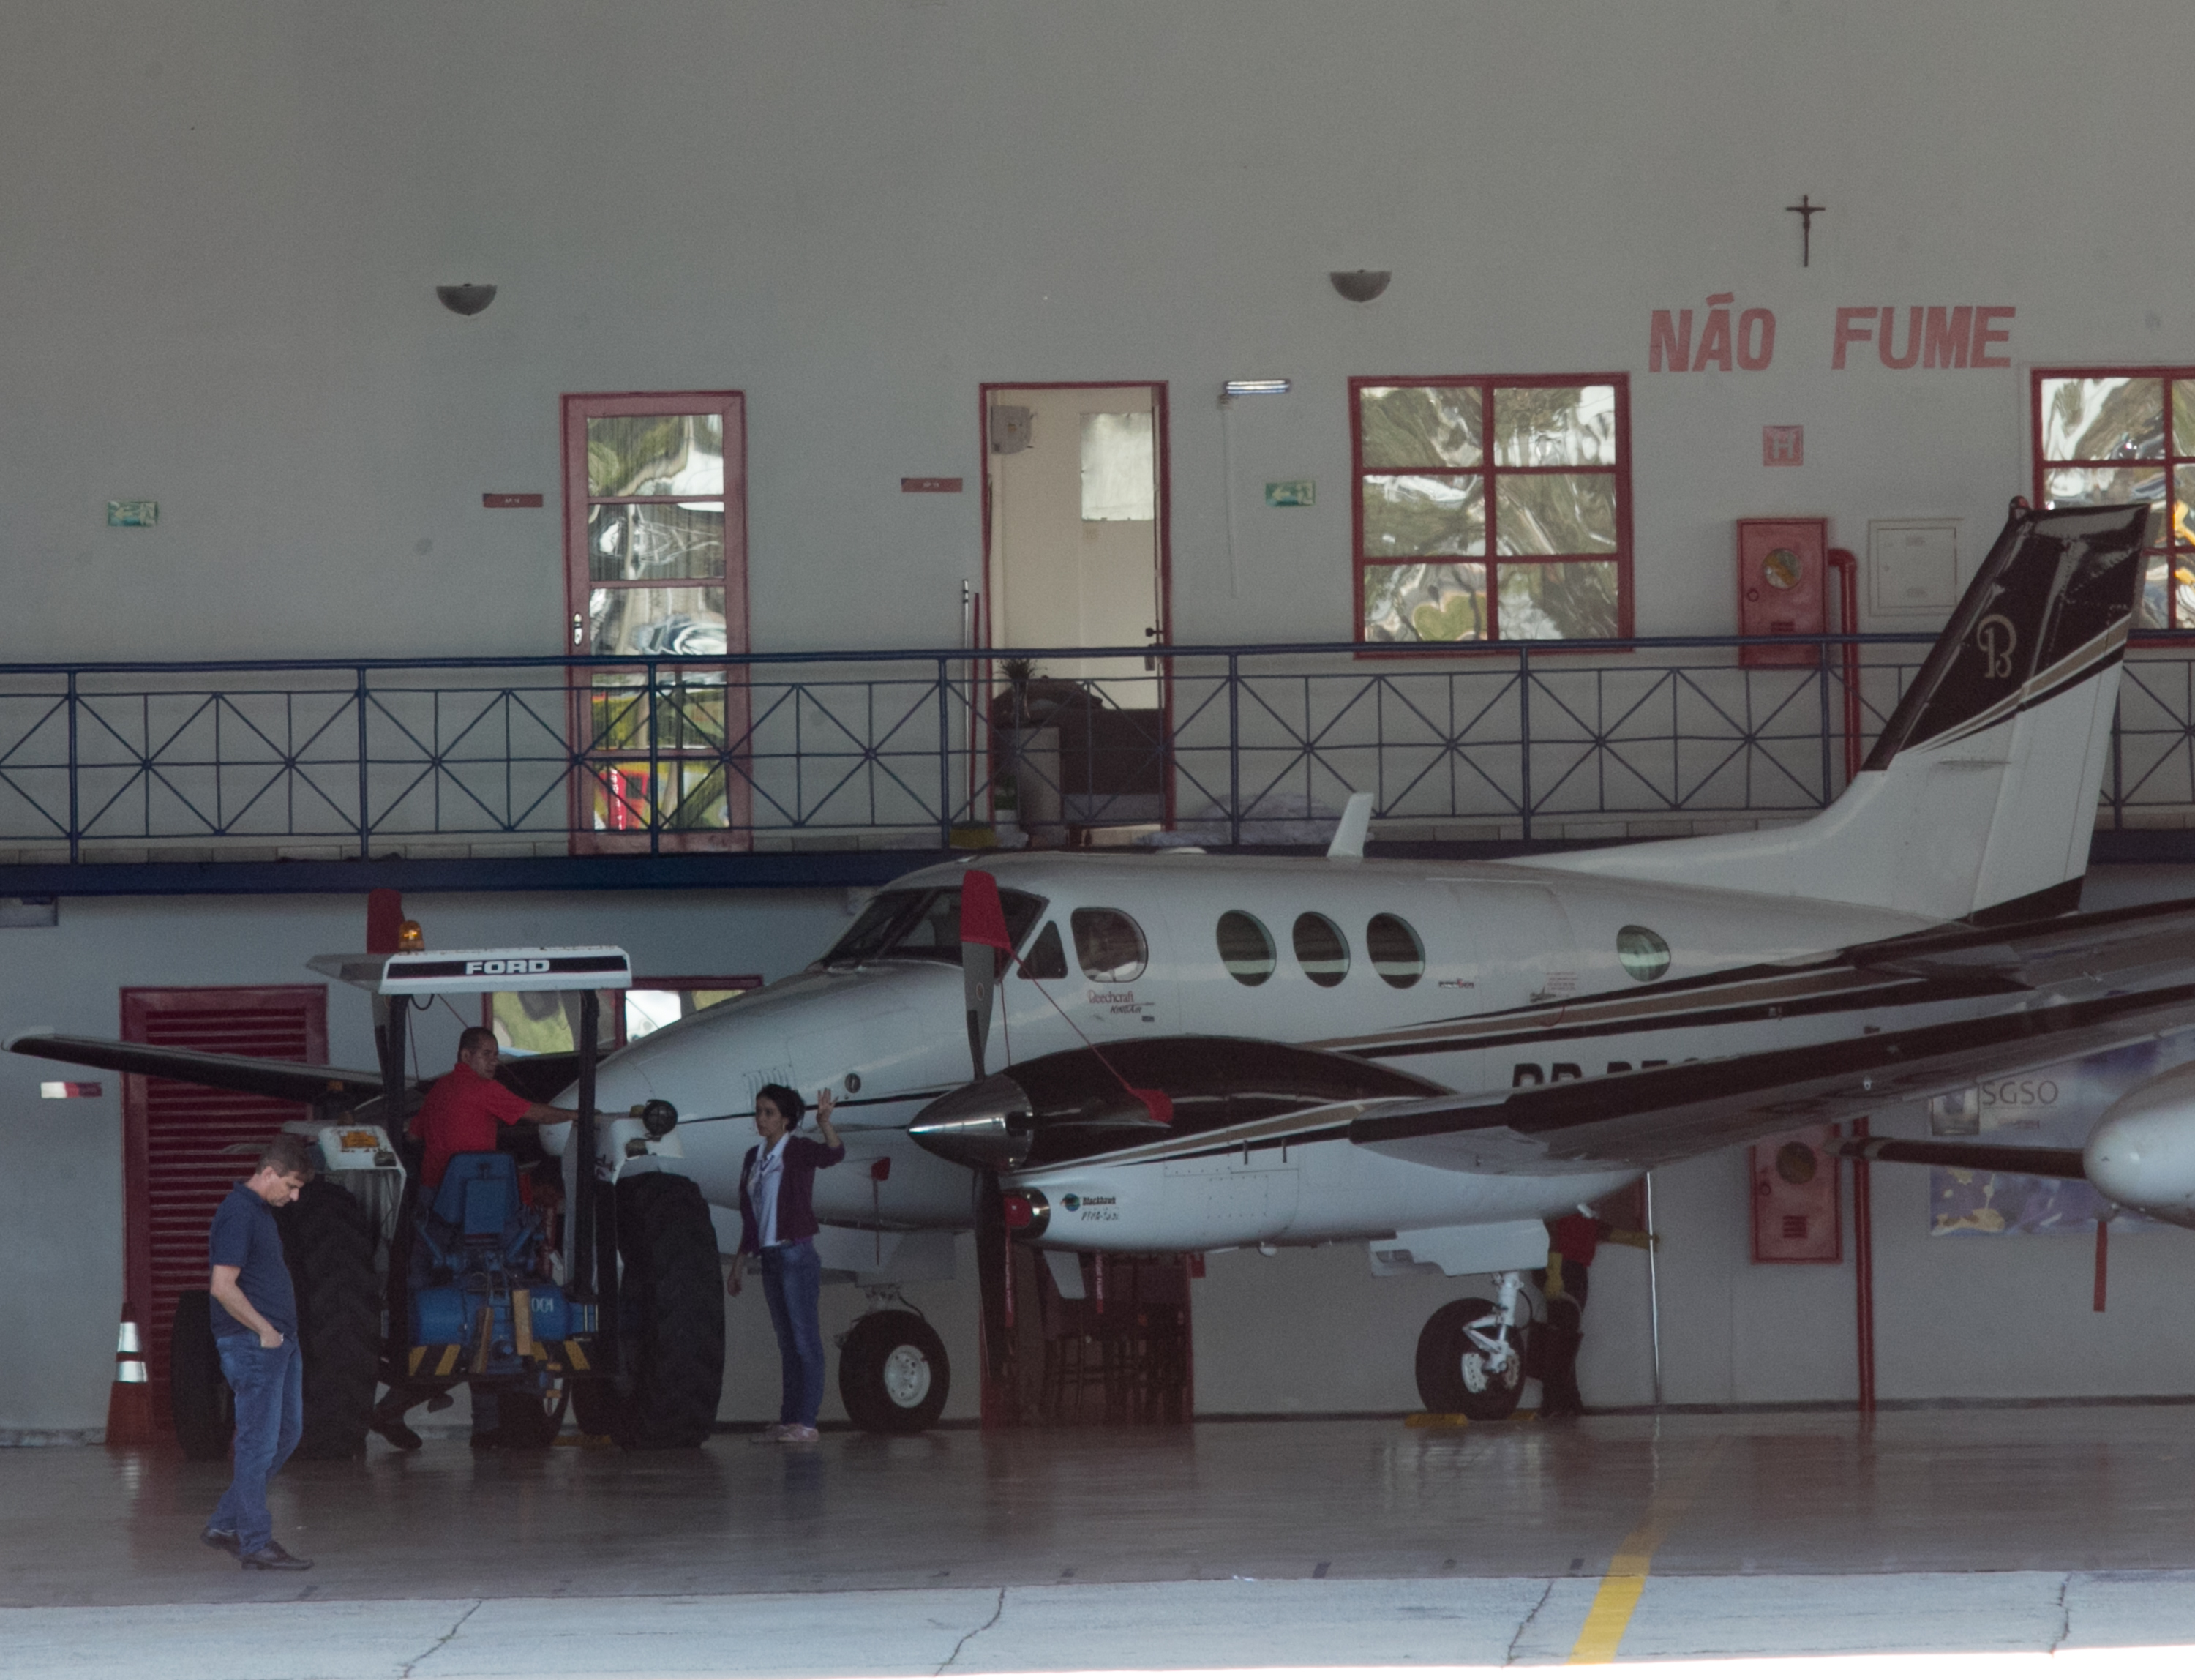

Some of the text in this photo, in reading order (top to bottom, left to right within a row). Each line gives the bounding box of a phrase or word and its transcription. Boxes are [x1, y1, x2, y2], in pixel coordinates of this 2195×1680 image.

[1649, 293, 2016, 372] NÃO FUME
[1773, 431, 1793, 460] H
[465, 959, 550, 975] FORD
[1087, 990, 1134, 1003] Beechcraft
[1982, 1081, 2059, 1106] SGSO
